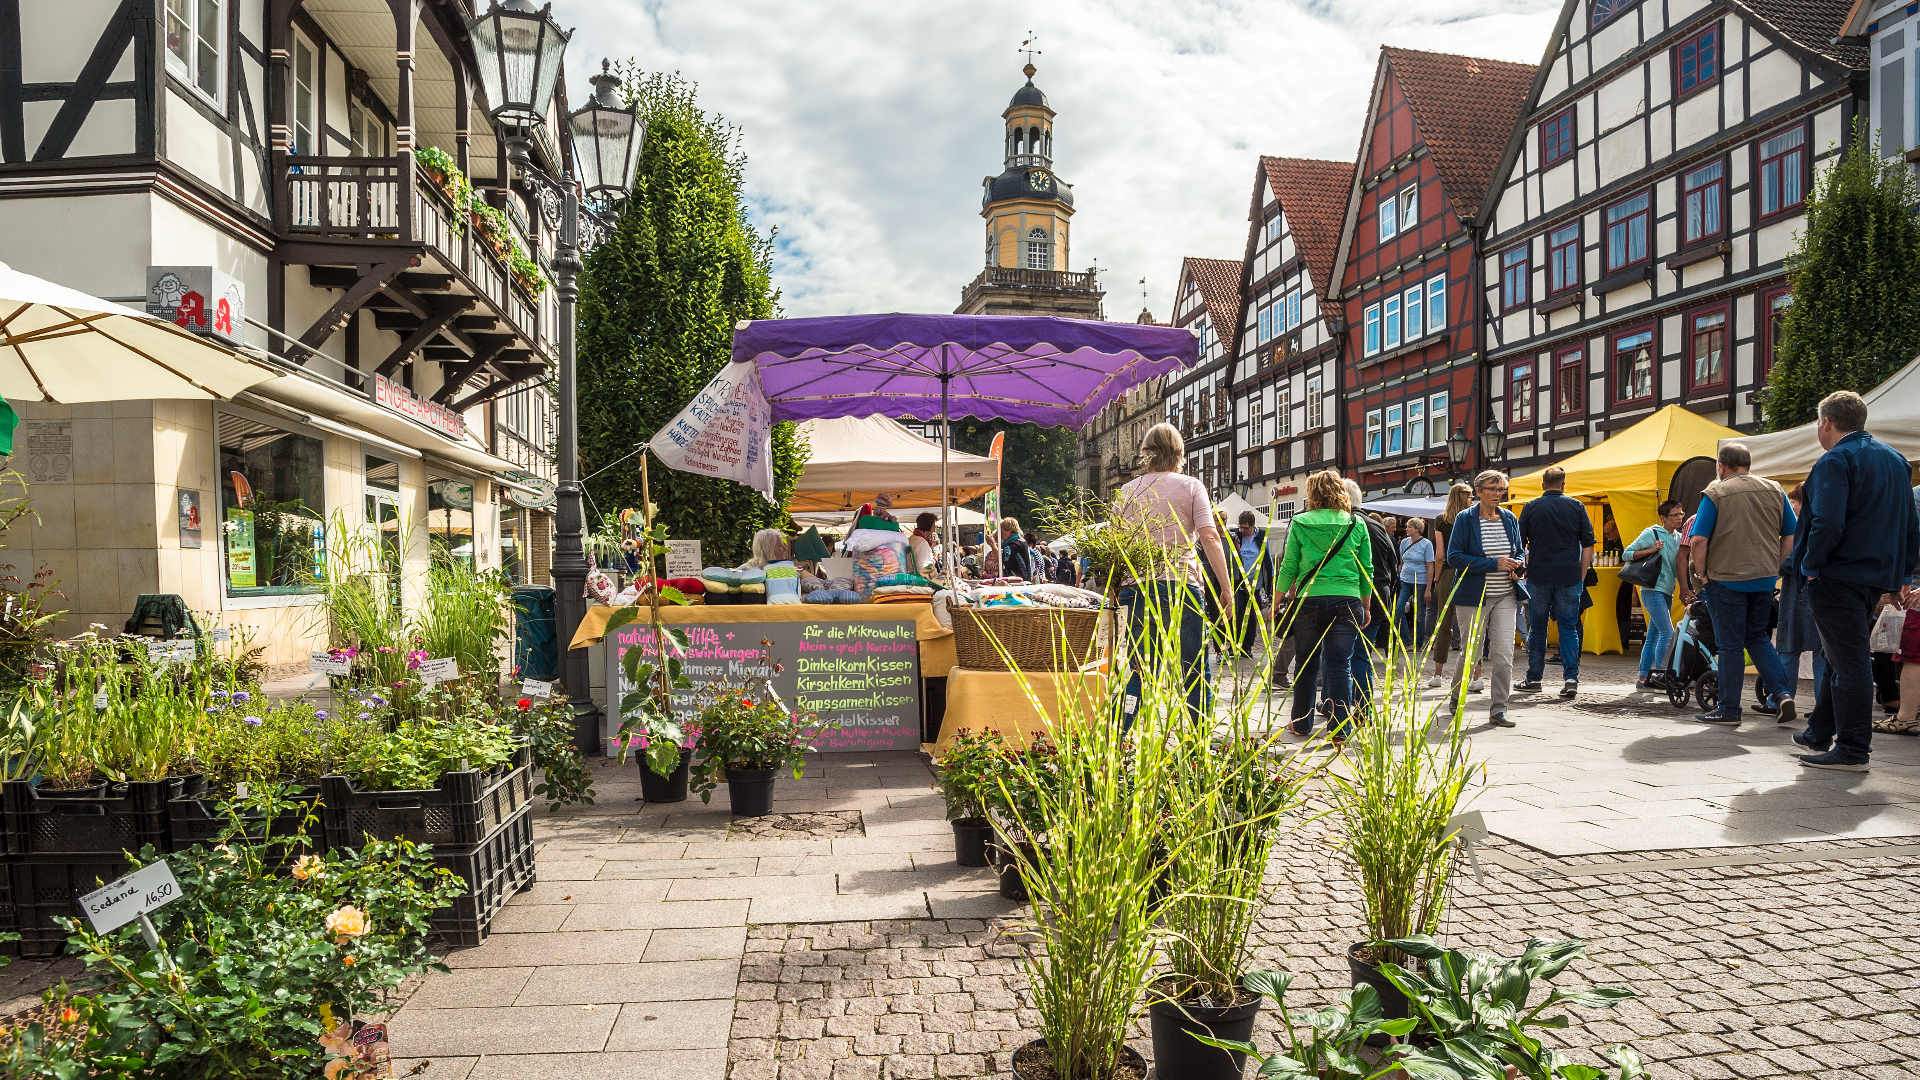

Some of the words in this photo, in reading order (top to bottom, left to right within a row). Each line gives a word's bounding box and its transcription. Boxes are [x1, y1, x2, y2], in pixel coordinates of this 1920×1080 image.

[376, 376, 464, 437] ENGEL-APOTHEKE
[802, 624, 824, 640] für
[827, 626, 845, 639] die
[847, 624, 915, 640] Mikrowelle:
[145, 882, 173, 907] 16,50
